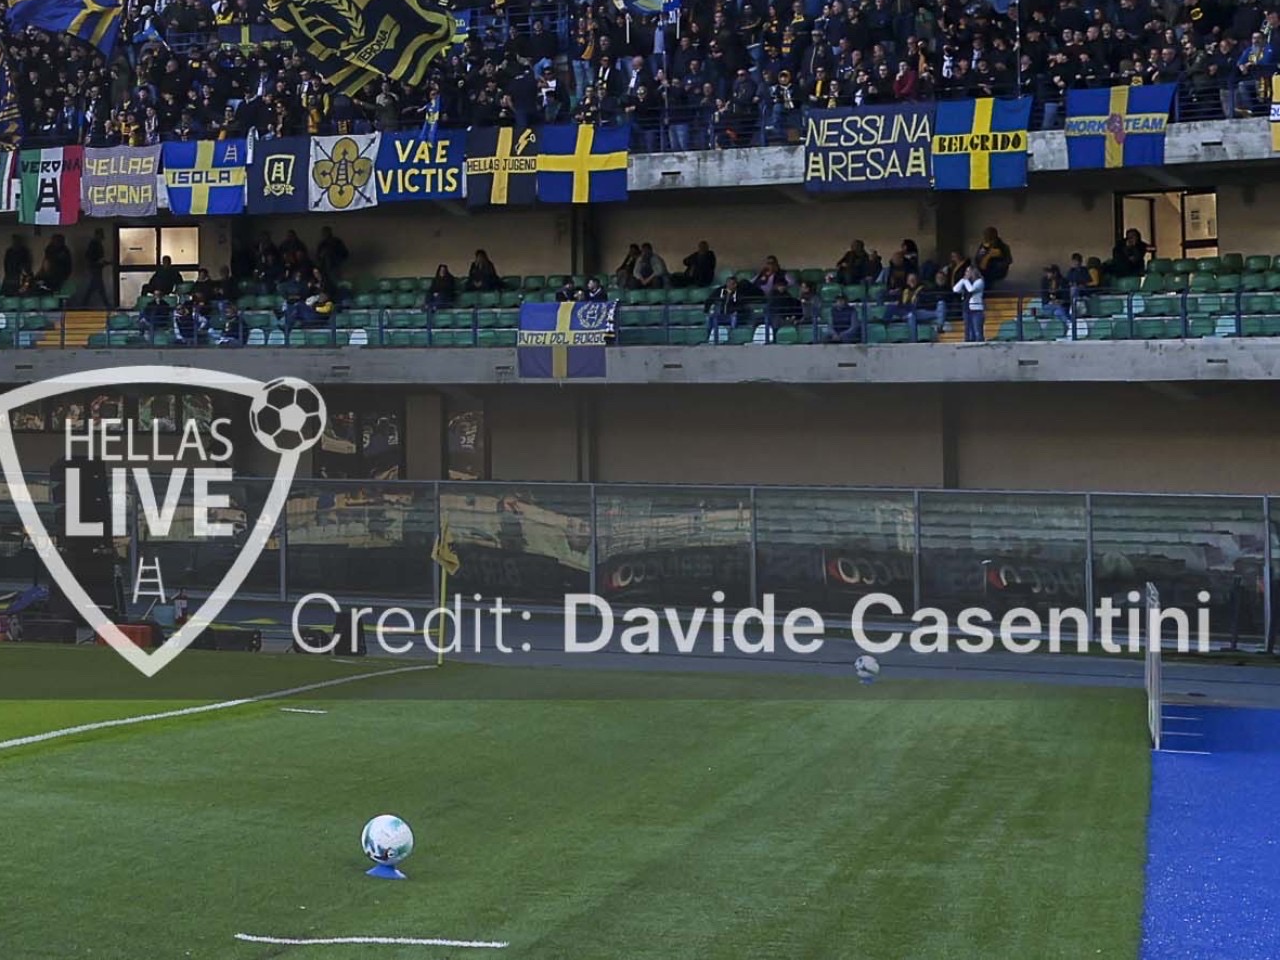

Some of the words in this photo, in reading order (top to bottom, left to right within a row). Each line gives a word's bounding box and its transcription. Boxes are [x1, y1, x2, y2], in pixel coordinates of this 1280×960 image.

[806, 113, 933, 148] NESSUNA
[1123, 116, 1164, 131] TEAM
[937, 132, 1023, 153] BELGRADO
[394, 139, 450, 165] VAE
[20, 159, 82, 175] VERONA
[466, 157, 500, 172] HELLAS
[171, 170, 231, 185] ISOLA
[377, 167, 459, 195] VICTIS
